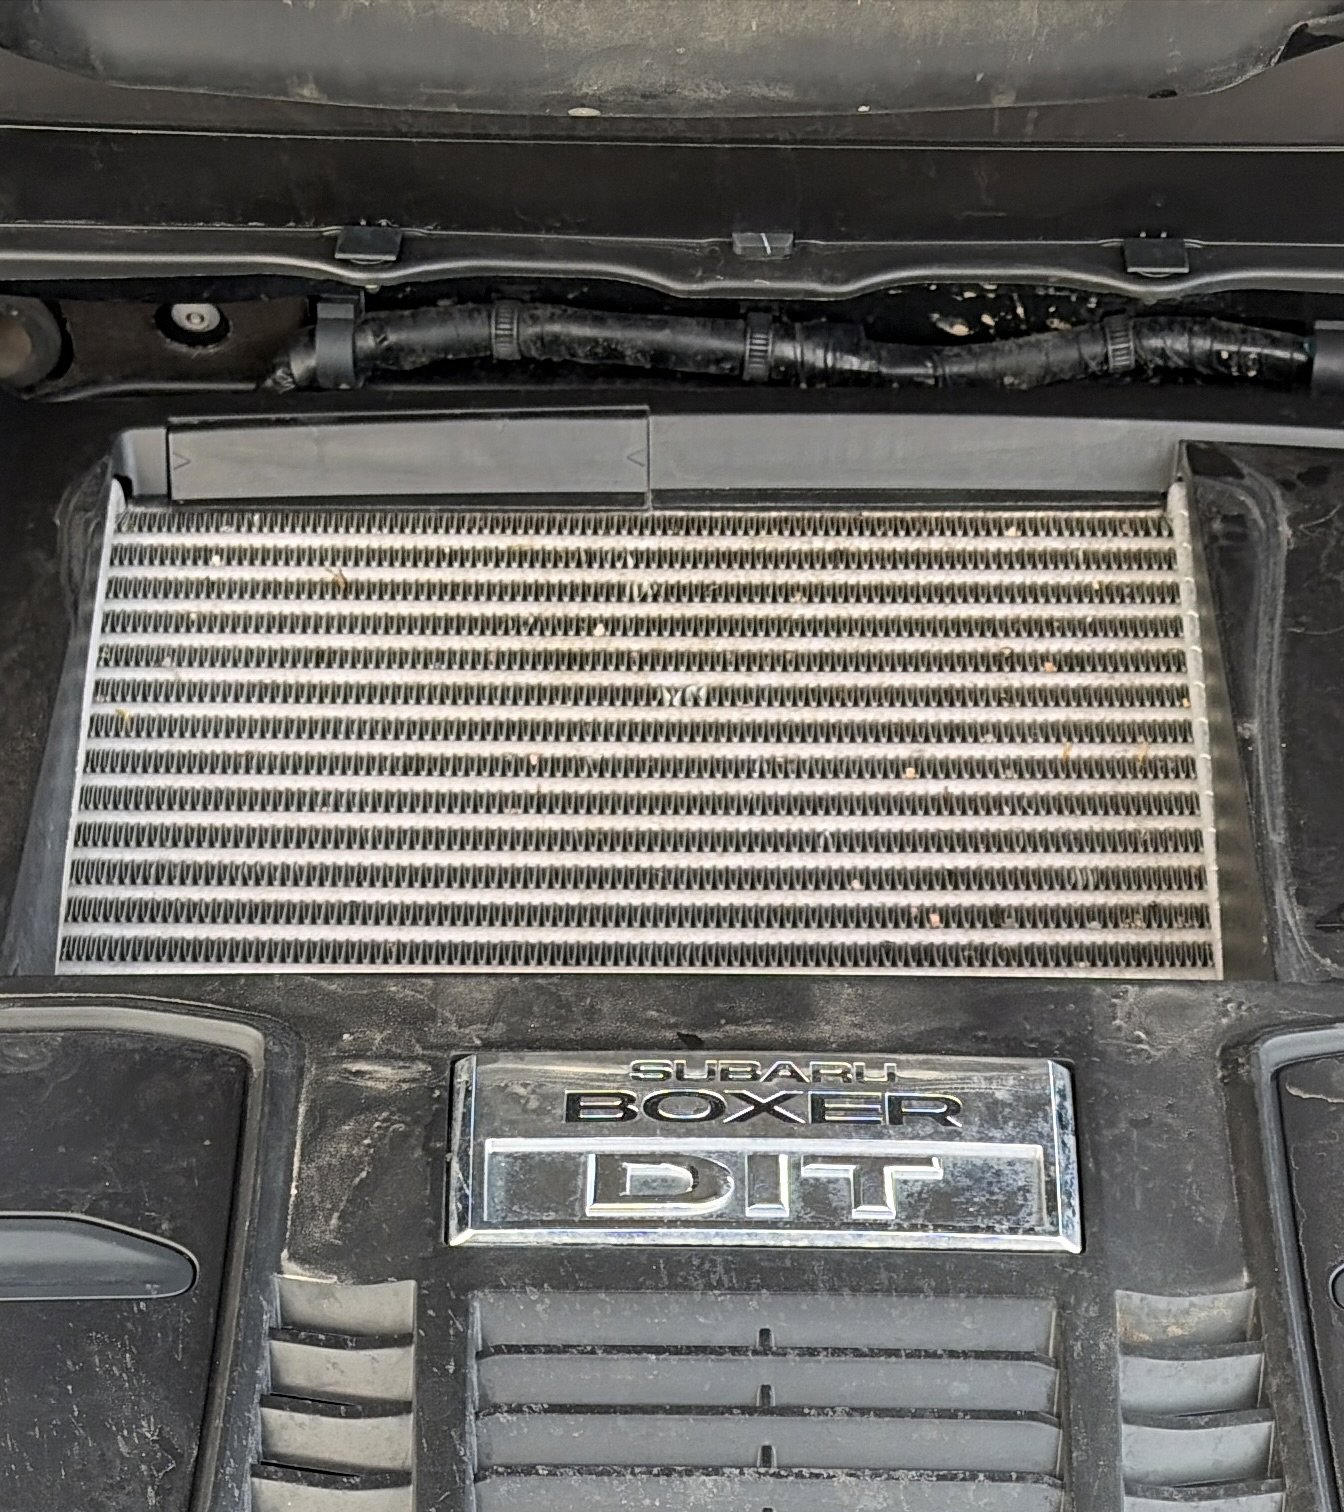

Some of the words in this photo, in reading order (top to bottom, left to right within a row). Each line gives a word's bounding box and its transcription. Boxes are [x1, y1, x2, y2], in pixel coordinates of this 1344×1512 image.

[629, 1058, 897, 1084] SUBARU
[564, 1088, 964, 1128] BOXER
[585, 1152, 944, 1219] DIT
